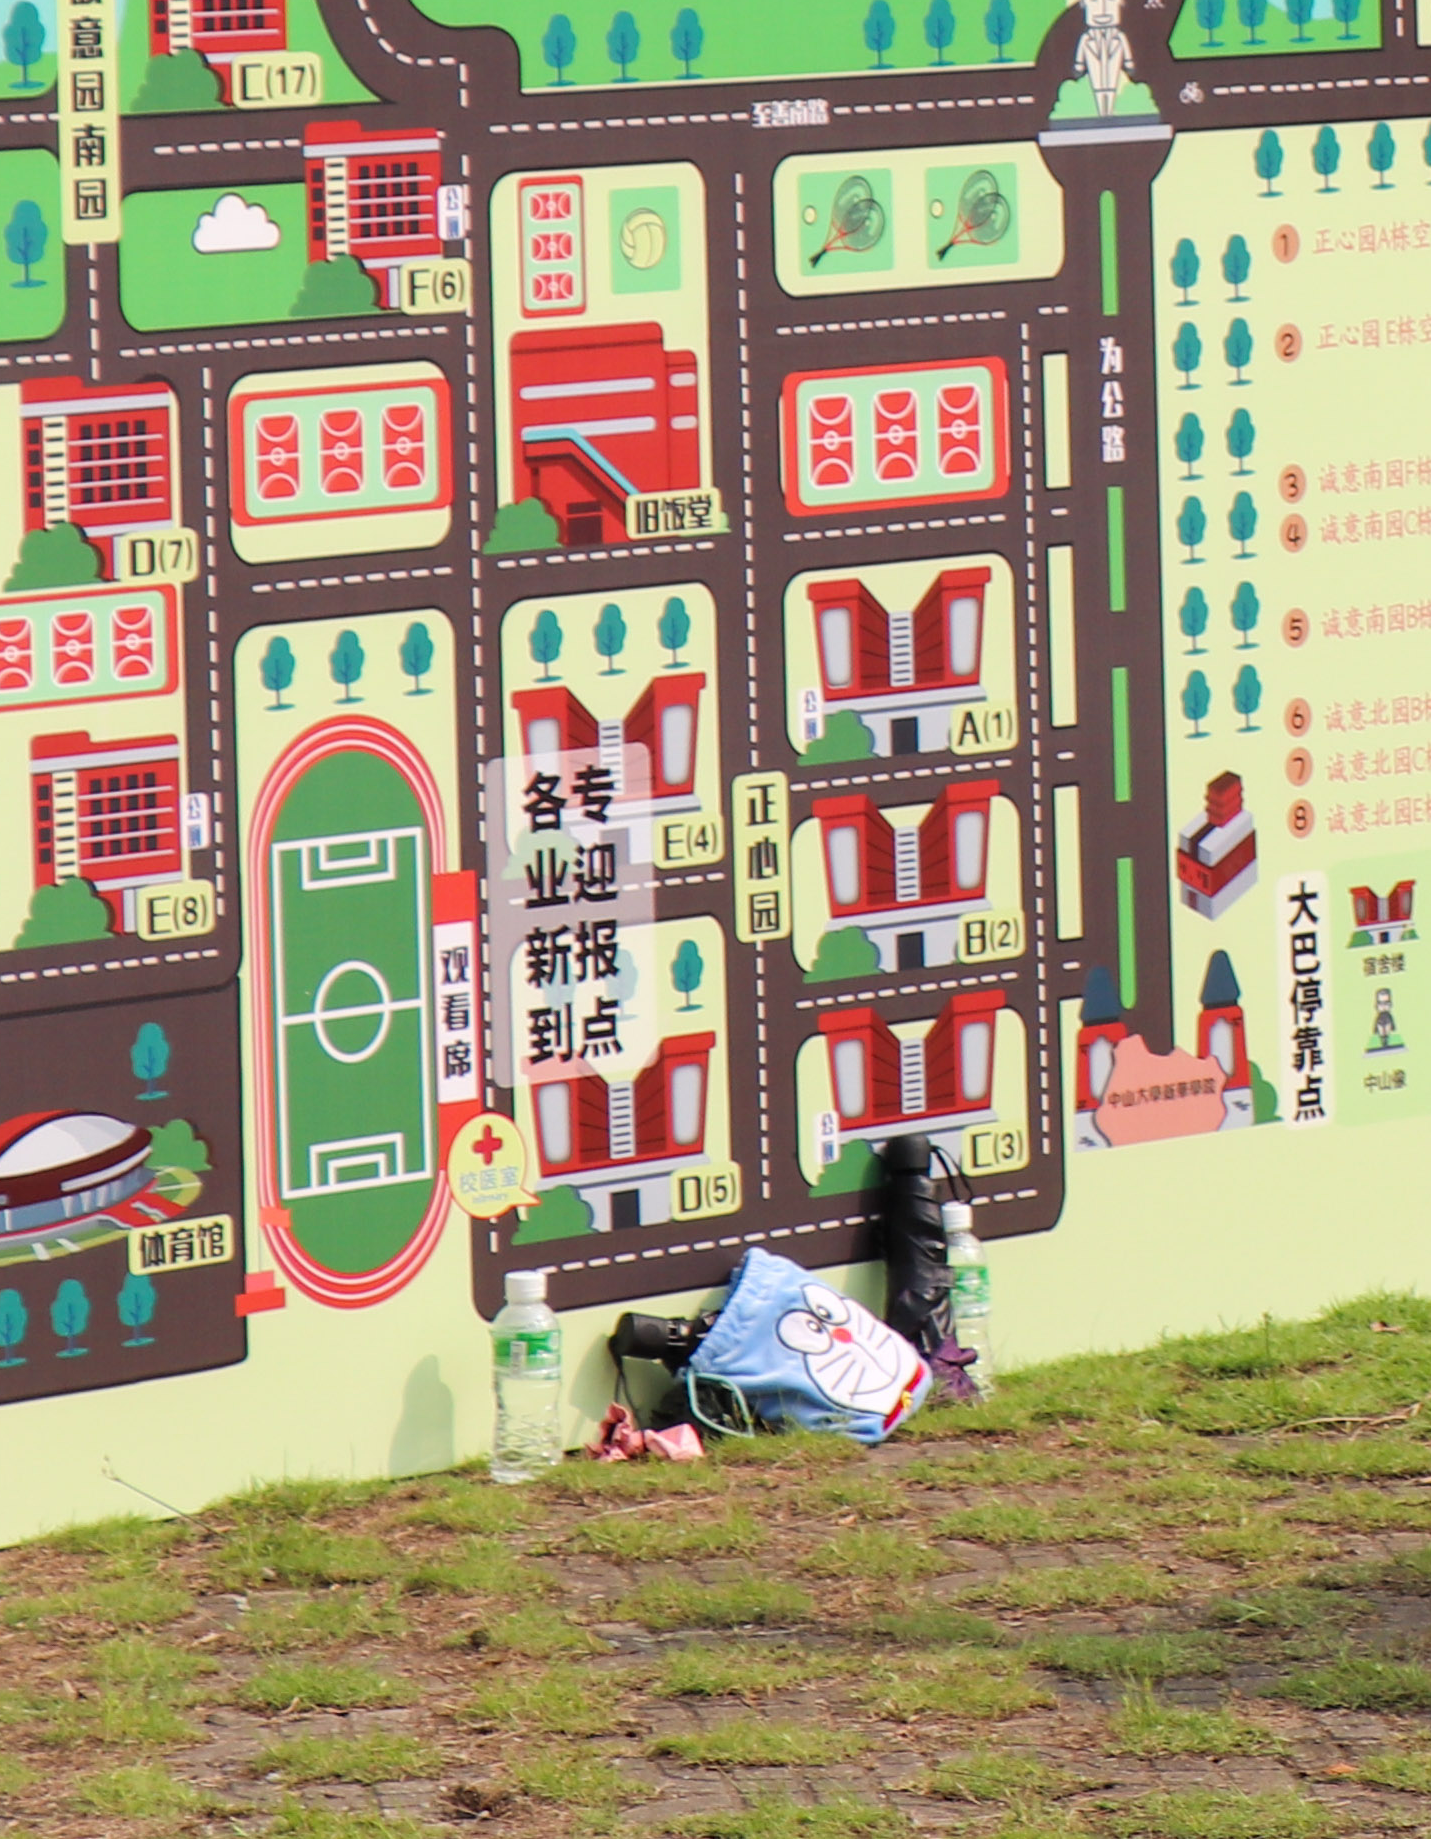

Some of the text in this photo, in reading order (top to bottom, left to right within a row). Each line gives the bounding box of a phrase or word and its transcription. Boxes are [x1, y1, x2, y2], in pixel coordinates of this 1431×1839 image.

[409, 267, 464, 306] F(6)
[1099, 337, 1126, 463] 为公路
[635, 495, 712, 536] 旧饭堂
[130, 537, 193, 576] D(7)
[957, 709, 1013, 747] A(1)
[662, 822, 717, 863] E(4)
[746, 785, 779, 936] 正心园
[147, 890, 207, 937] E(8)
[965, 918, 1020, 957] B(2)
[439, 944, 473, 1079] 观看席
[1288, 882, 1325, 1121] 大巴停靠点
[678, 1173, 737, 1213] D(5)
[139, 1221, 226, 1267] 体育馆
